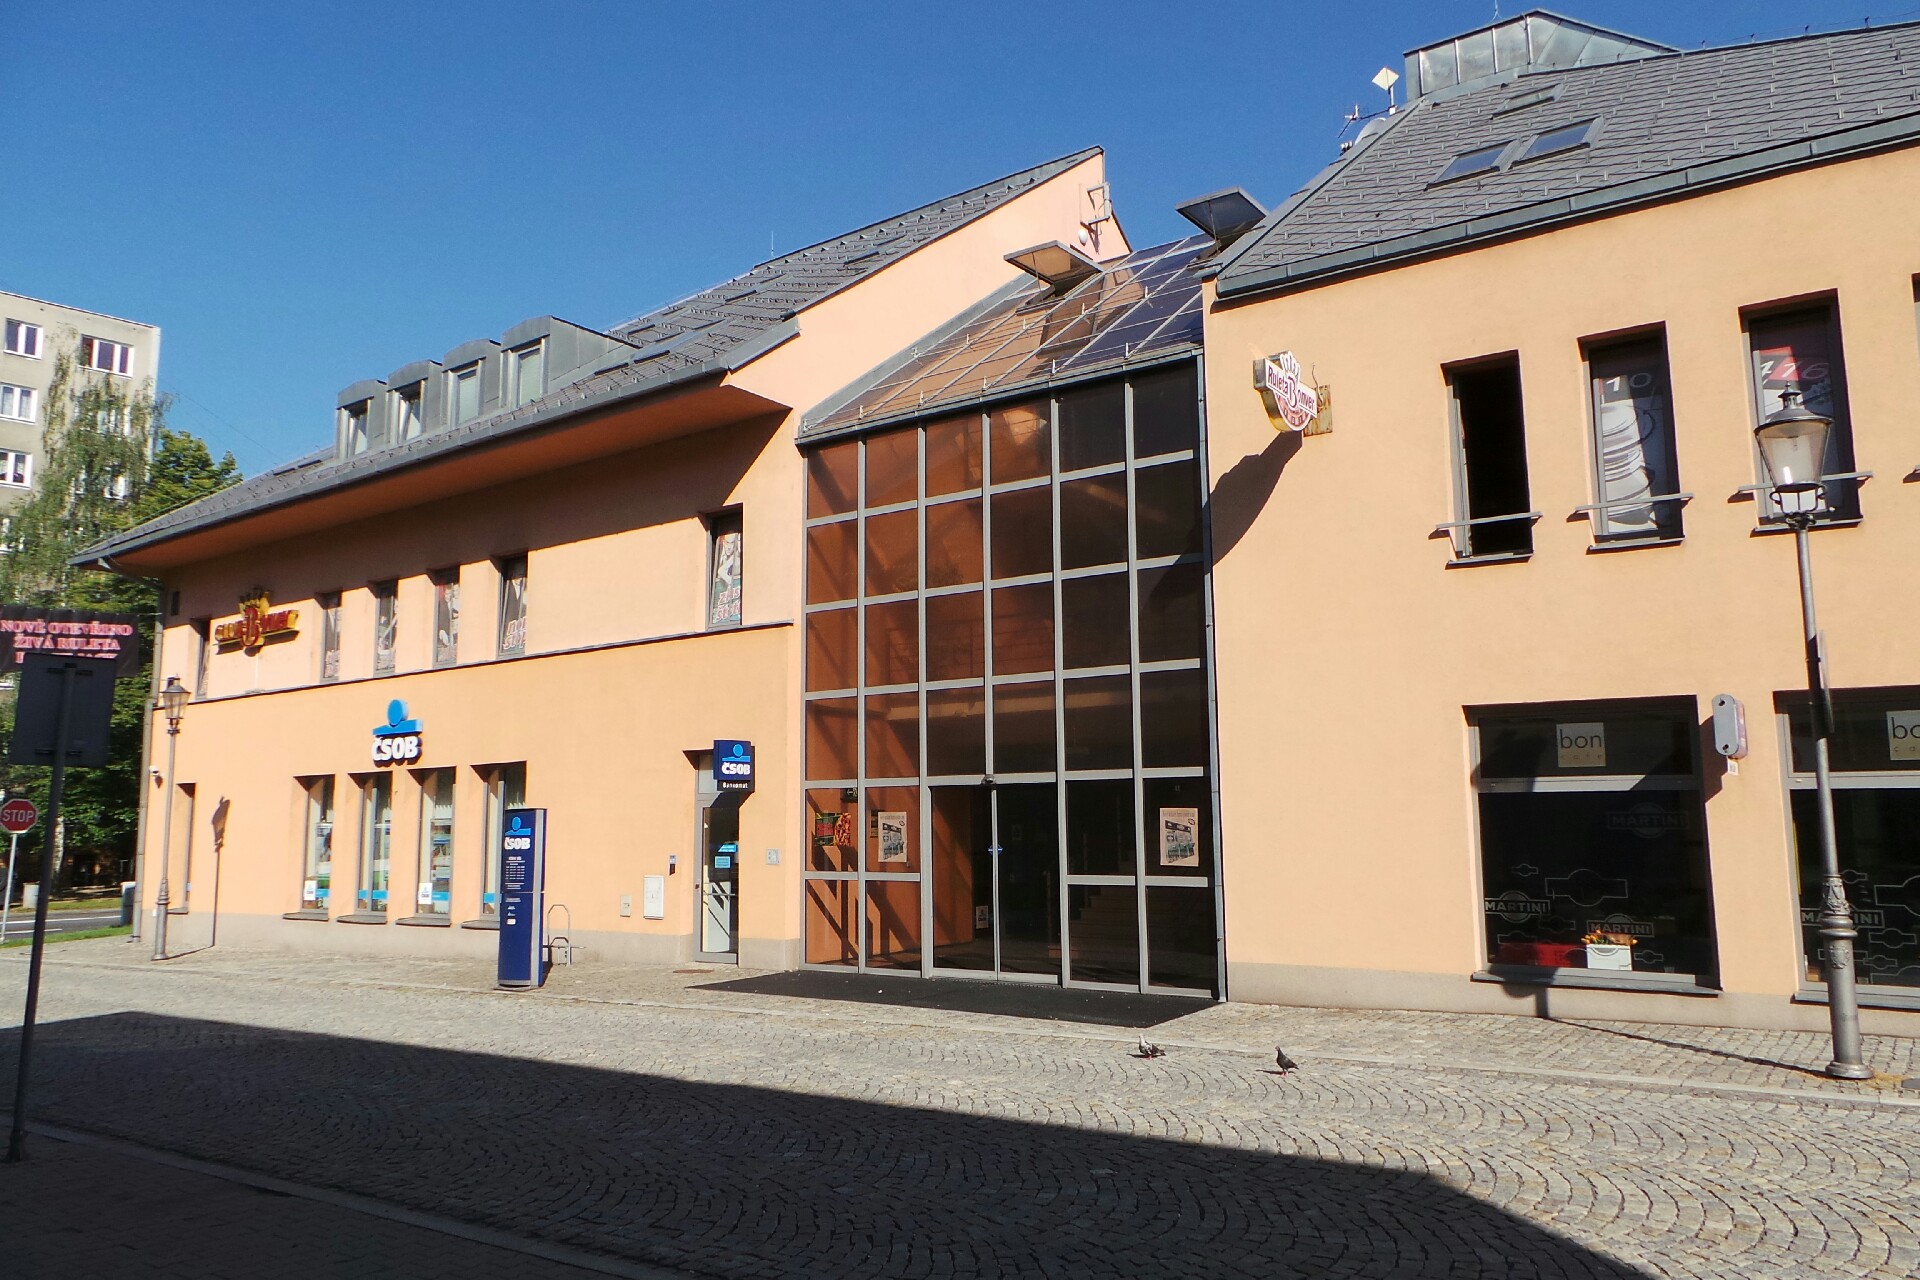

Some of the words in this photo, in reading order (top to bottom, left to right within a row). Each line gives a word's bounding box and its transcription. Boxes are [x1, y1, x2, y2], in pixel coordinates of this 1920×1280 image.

[1267, 365, 1288, 396] Ruleta
[48, 621, 133, 636] OTEVŘENO
[13, 633, 55, 649] ŽIVÁ
[57, 637, 121, 650] RULETA
[1560, 729, 1602, 749] bon
[372, 736, 419, 761] ČSOB
[721, 762, 751, 775] ČSOB
[2, 810, 34, 822] STOP
[1612, 815, 1686, 828] MARTINI
[504, 837, 531, 850] ČSOB
[1484, 901, 1546, 912] MARTINI
[1801, 912, 1880, 924] MINI
[1590, 922, 1651, 934] MARTINI
